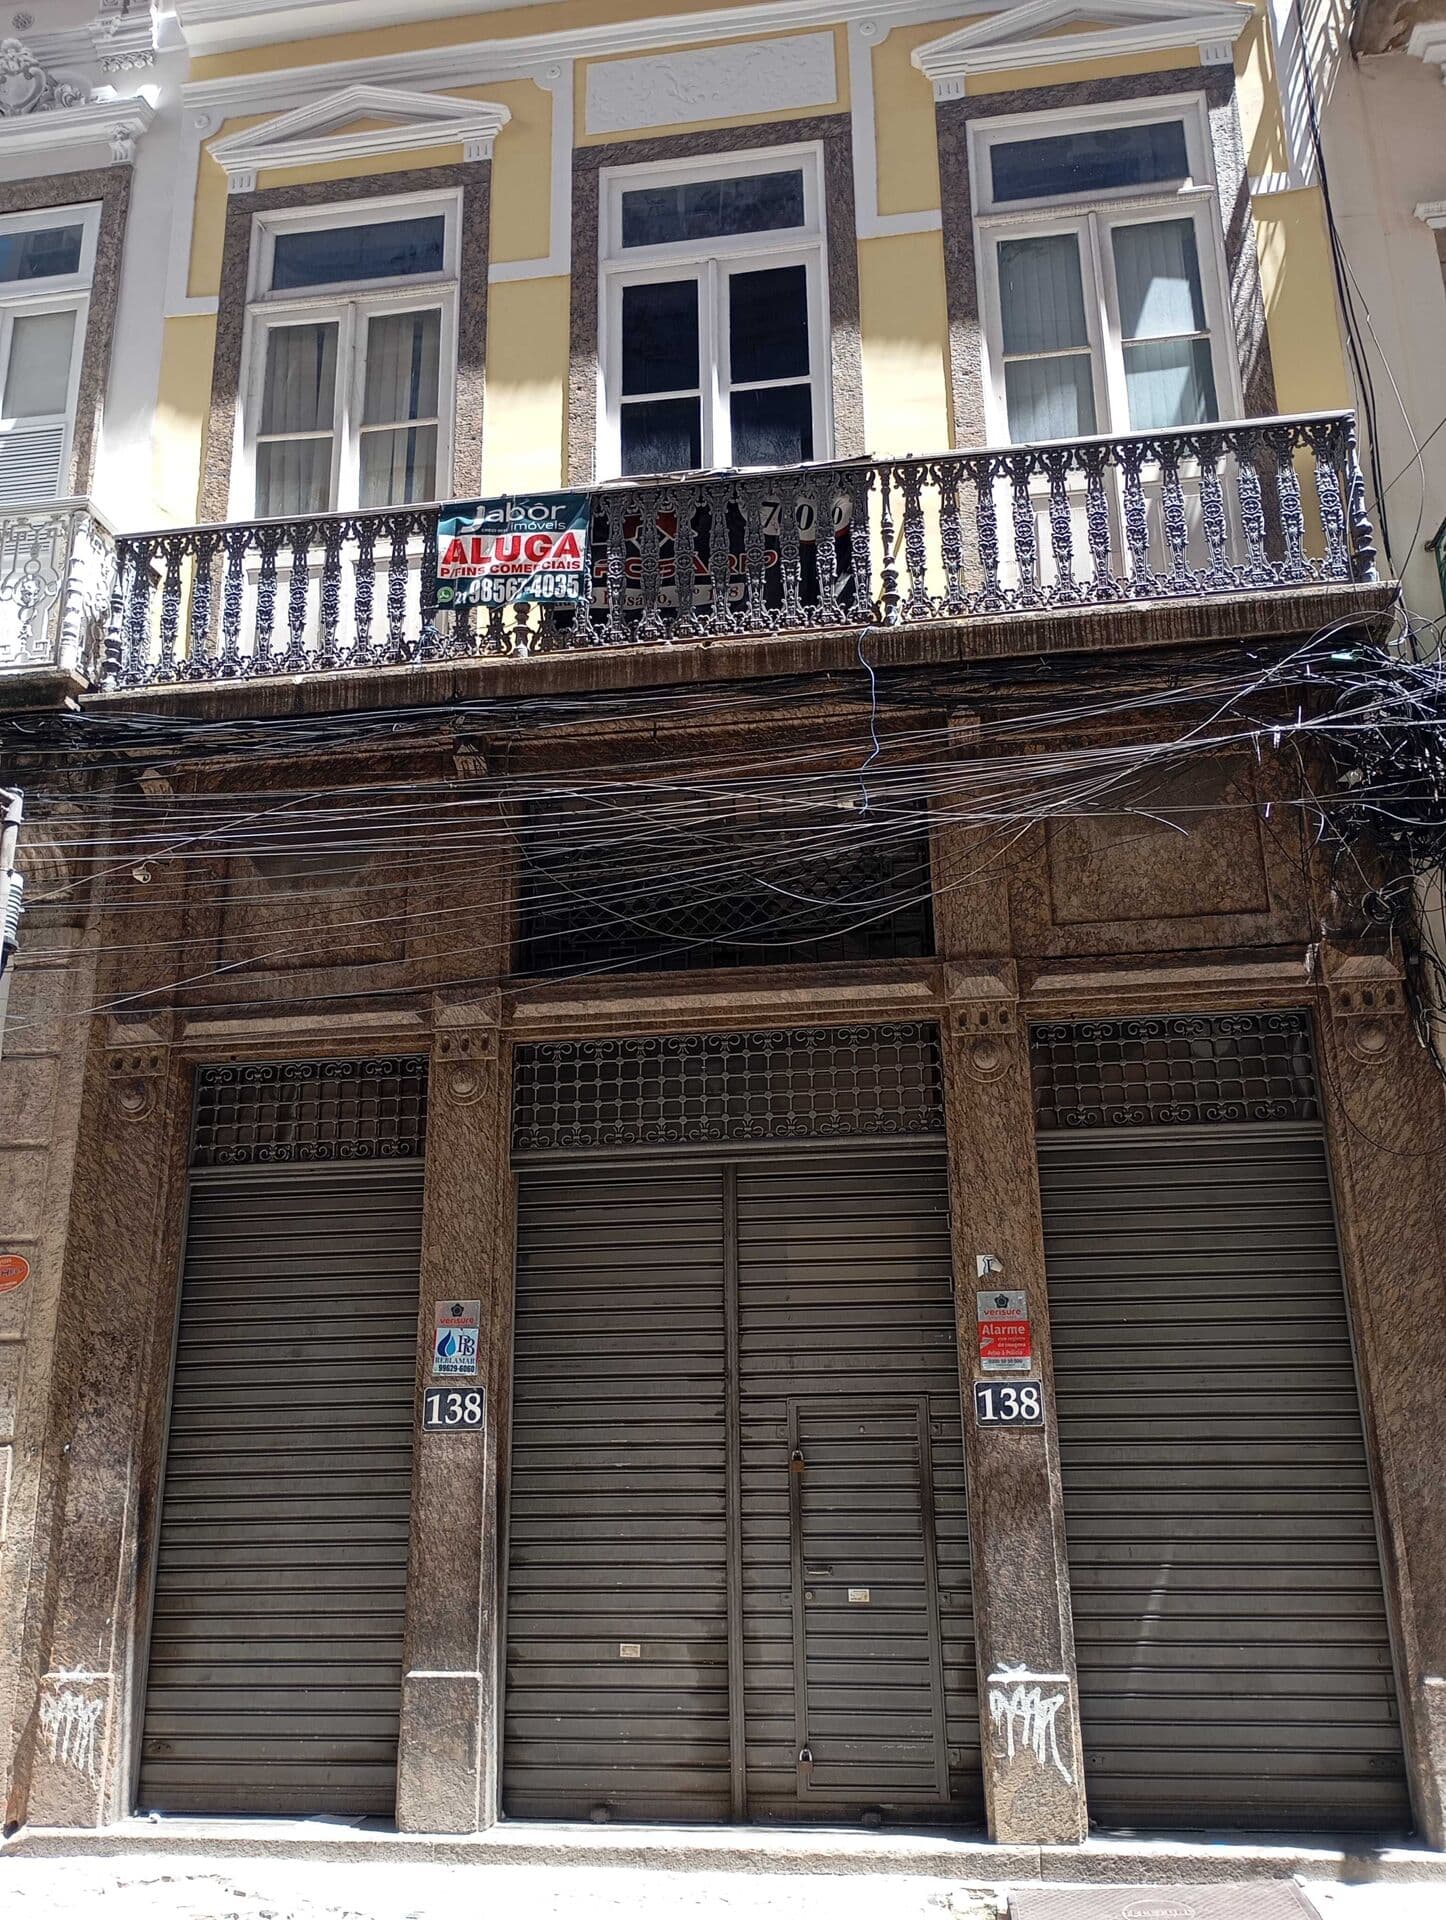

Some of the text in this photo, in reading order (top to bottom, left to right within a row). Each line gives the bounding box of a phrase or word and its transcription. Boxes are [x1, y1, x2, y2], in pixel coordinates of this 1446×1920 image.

[458, 501, 567, 534] Jabôr
[510, 519, 567, 532] imóveis
[441, 531, 581, 565] ALUGA
[440, 566, 485, 578] P/FINS
[455, 591, 467, 603] 21
[982, 1324, 1025, 1335] Alarme
[426, 1392, 482, 1424] 138
[978, 1386, 1040, 1421] 138
